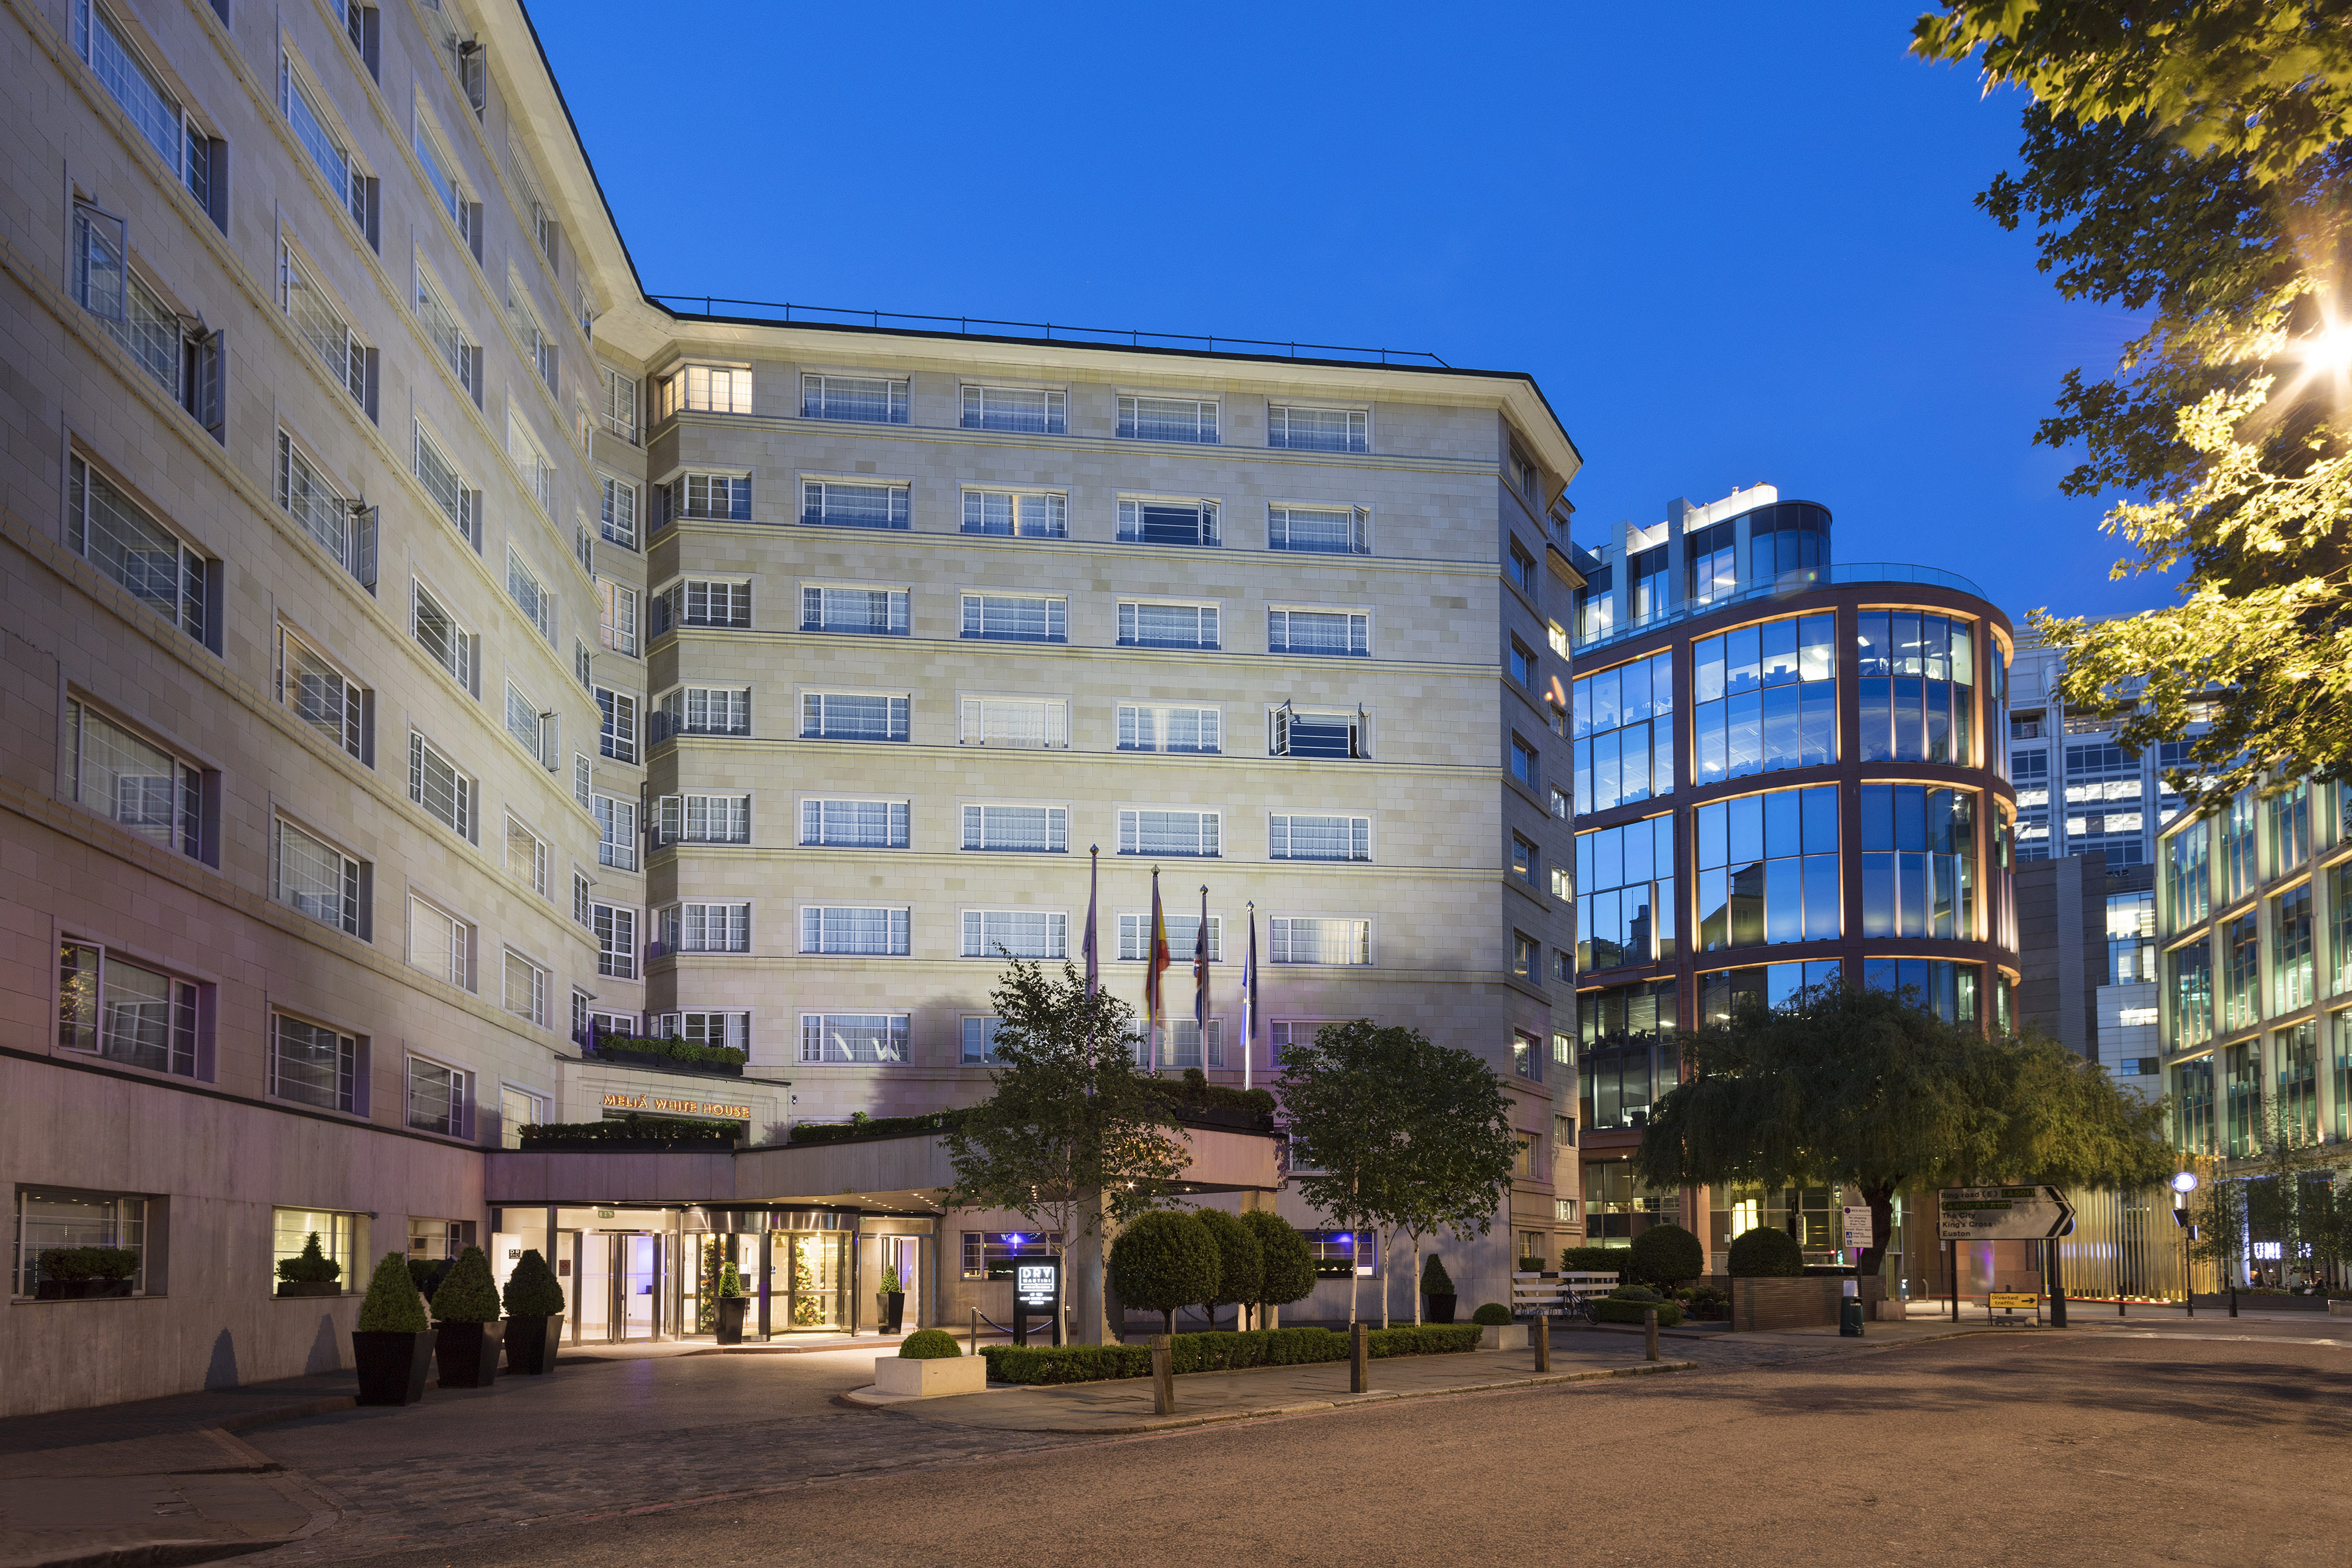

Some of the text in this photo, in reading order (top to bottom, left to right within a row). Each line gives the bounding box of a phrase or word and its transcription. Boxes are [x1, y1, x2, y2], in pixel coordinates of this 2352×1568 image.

[655, 1099, 697, 1113] WHITE
[702, 1103, 750, 1118] HOUSE
[1022, 1268, 1051, 1279] DRY
